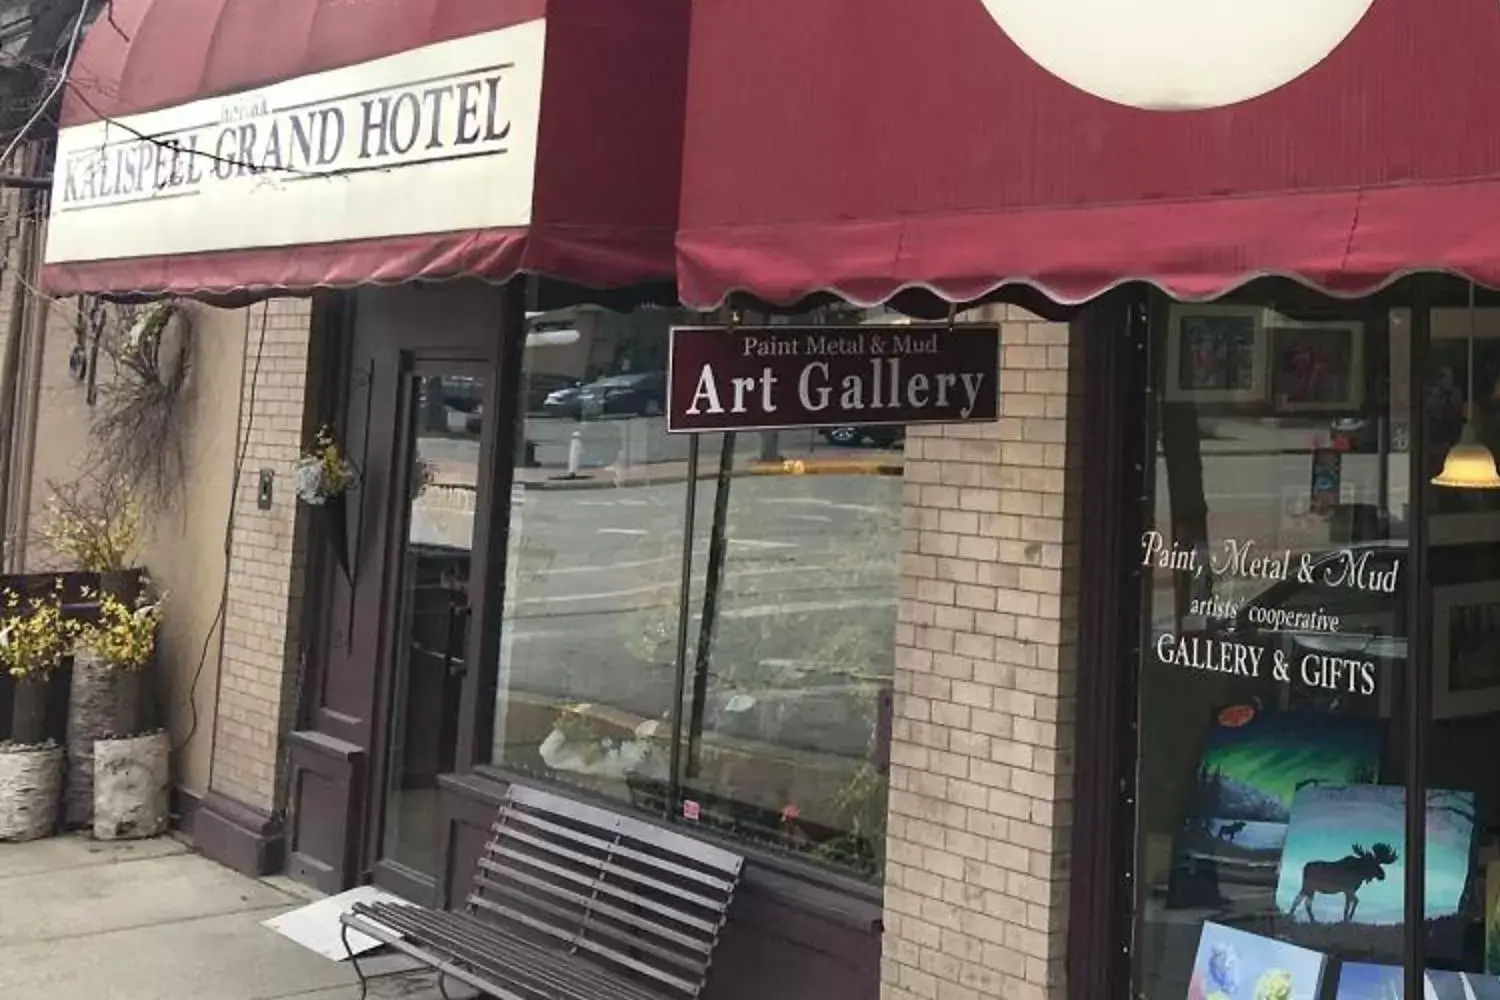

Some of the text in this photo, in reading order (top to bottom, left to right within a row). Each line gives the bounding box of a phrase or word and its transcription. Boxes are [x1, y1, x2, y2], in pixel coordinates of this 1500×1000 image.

[64, 76, 511, 203] KALISPELL GRAND HOTEL
[744, 333, 938, 357] Paint Metal & Mud
[685, 357, 985, 420] Art Gallery
[1141, 531, 1399, 593] Paint, Metal & Mud
[1190, 596, 1339, 633] artists' cooperative
[1157, 633, 1375, 695] GALLERY & GIFTS
